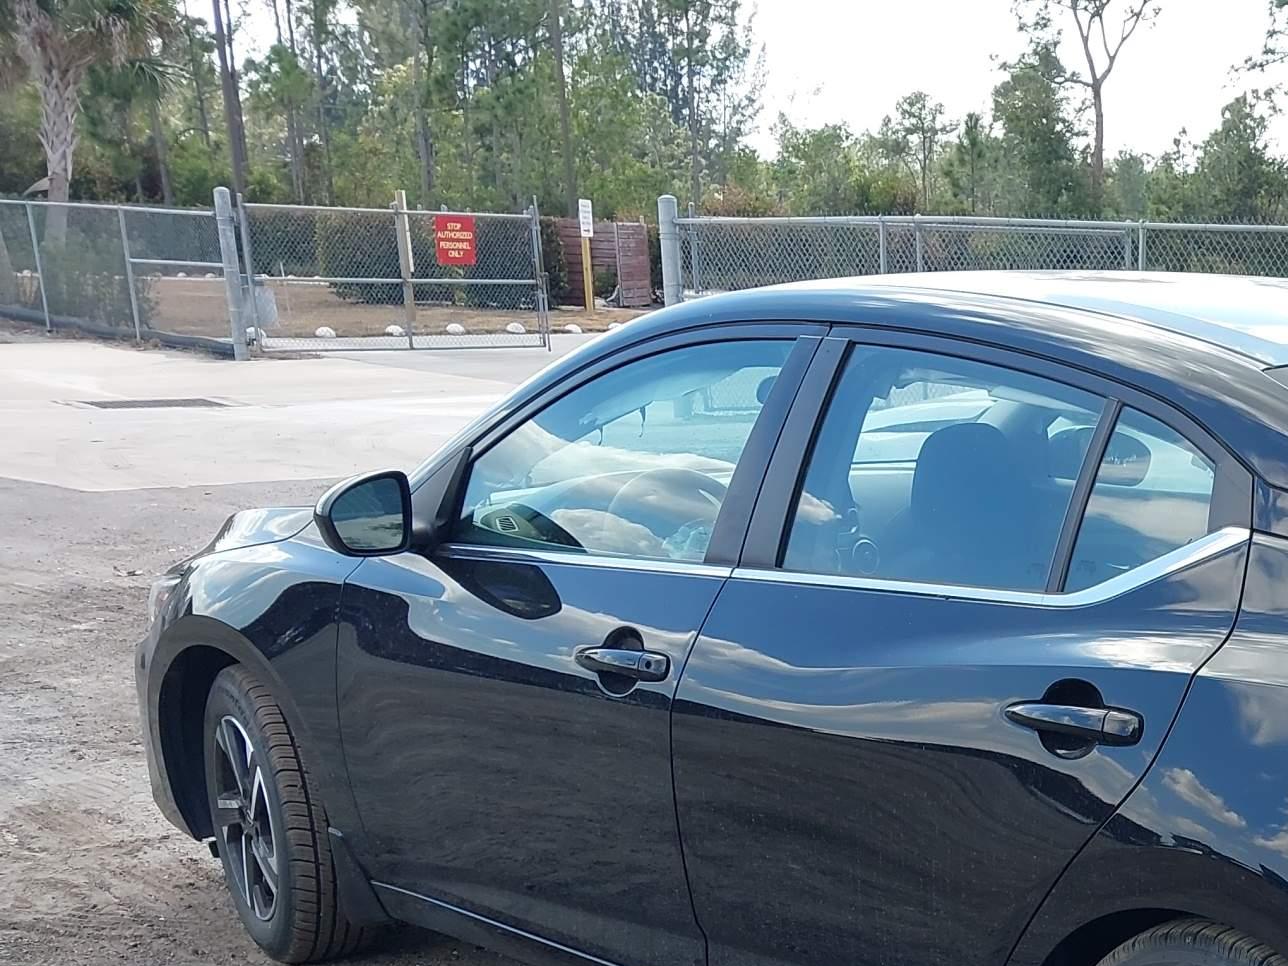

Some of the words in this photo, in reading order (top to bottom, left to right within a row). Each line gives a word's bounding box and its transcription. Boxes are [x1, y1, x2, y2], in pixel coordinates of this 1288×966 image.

[447, 222, 461, 230] STOP
[437, 231, 473, 239] AUTHORIZED
[440, 241, 472, 250] PERSONNEL
